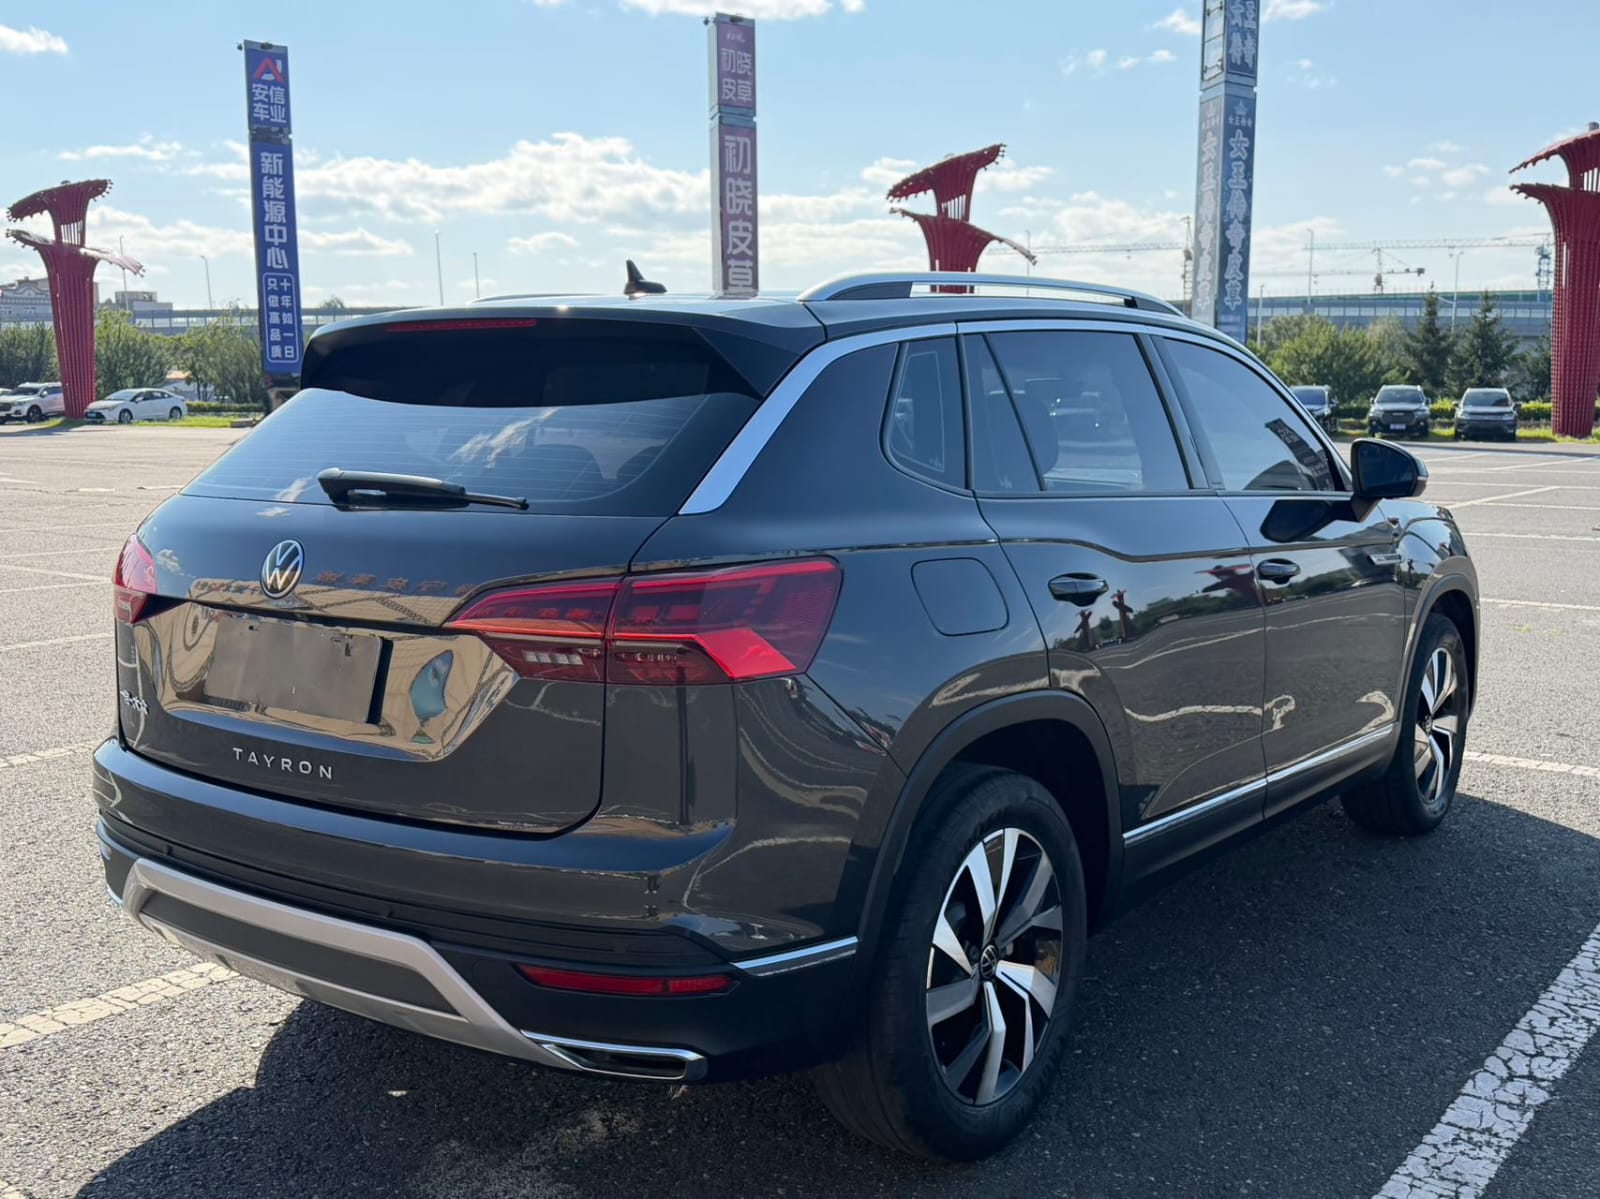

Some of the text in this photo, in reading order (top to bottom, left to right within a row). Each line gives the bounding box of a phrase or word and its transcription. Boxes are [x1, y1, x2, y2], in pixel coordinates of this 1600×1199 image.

[251, 83, 286, 105] 安信
[252, 102, 287, 124] 车业
[260, 151, 289, 269] 新能源中心
[723, 135, 754, 289] 初晓皮草
[267, 277, 282, 358] 只做高品质
[280, 278, 295, 358] 十年如一日
[232, 747, 332, 779] TAYRON
